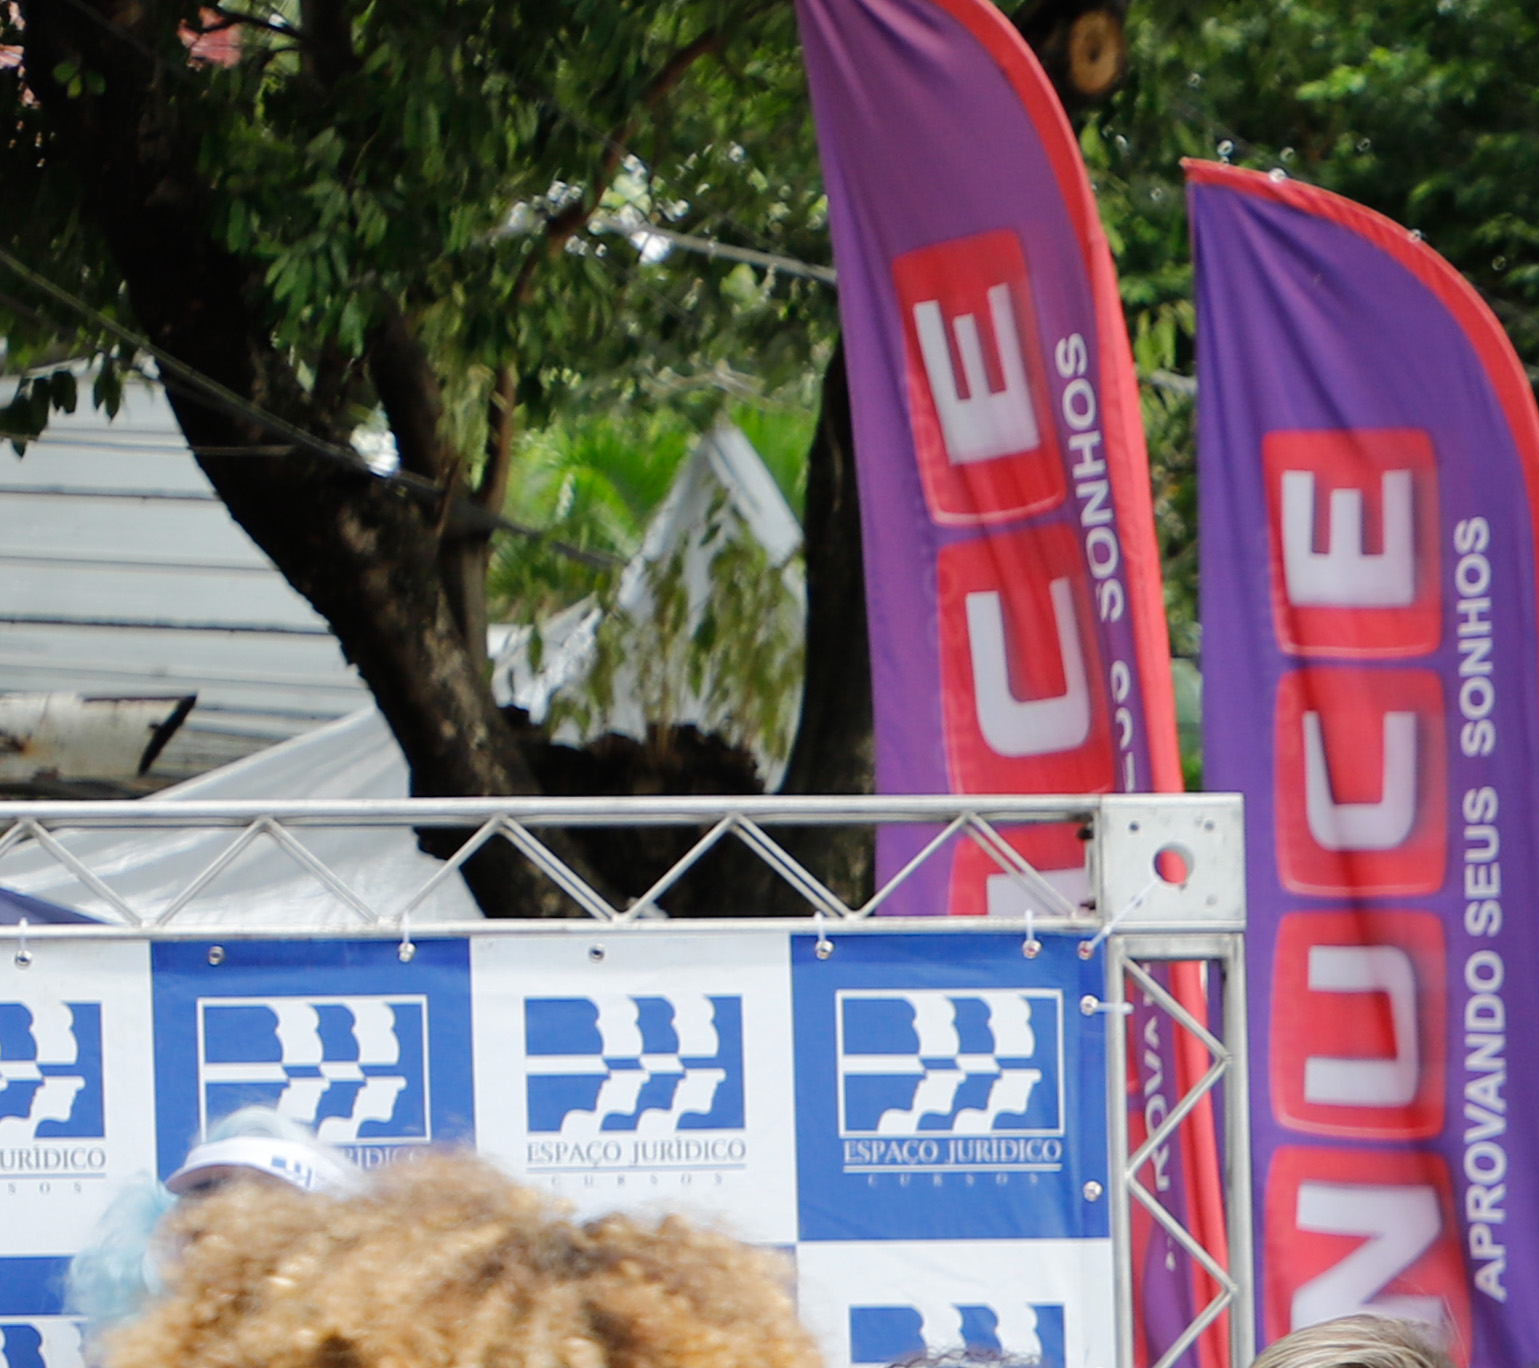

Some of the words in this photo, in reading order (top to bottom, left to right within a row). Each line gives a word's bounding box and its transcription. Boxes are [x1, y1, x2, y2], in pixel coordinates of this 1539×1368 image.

[1054, 332, 1124, 624] SONHOS
[1454, 515, 1497, 758] SONHOS
[1281, 468, 1446, 1345] NUCE
[1462, 786, 1503, 937] SEUS
[0, 1143, 106, 1172] URÍDICO
[526, 1139, 622, 1167] ESPAÇO
[628, 1135, 747, 1164] JURÍDICO
[843, 1138, 940, 1166] ESPAÇO
[943, 1135, 1063, 1164] JURÍDICO
[1463, 950, 1507, 1302] APROVANDO
